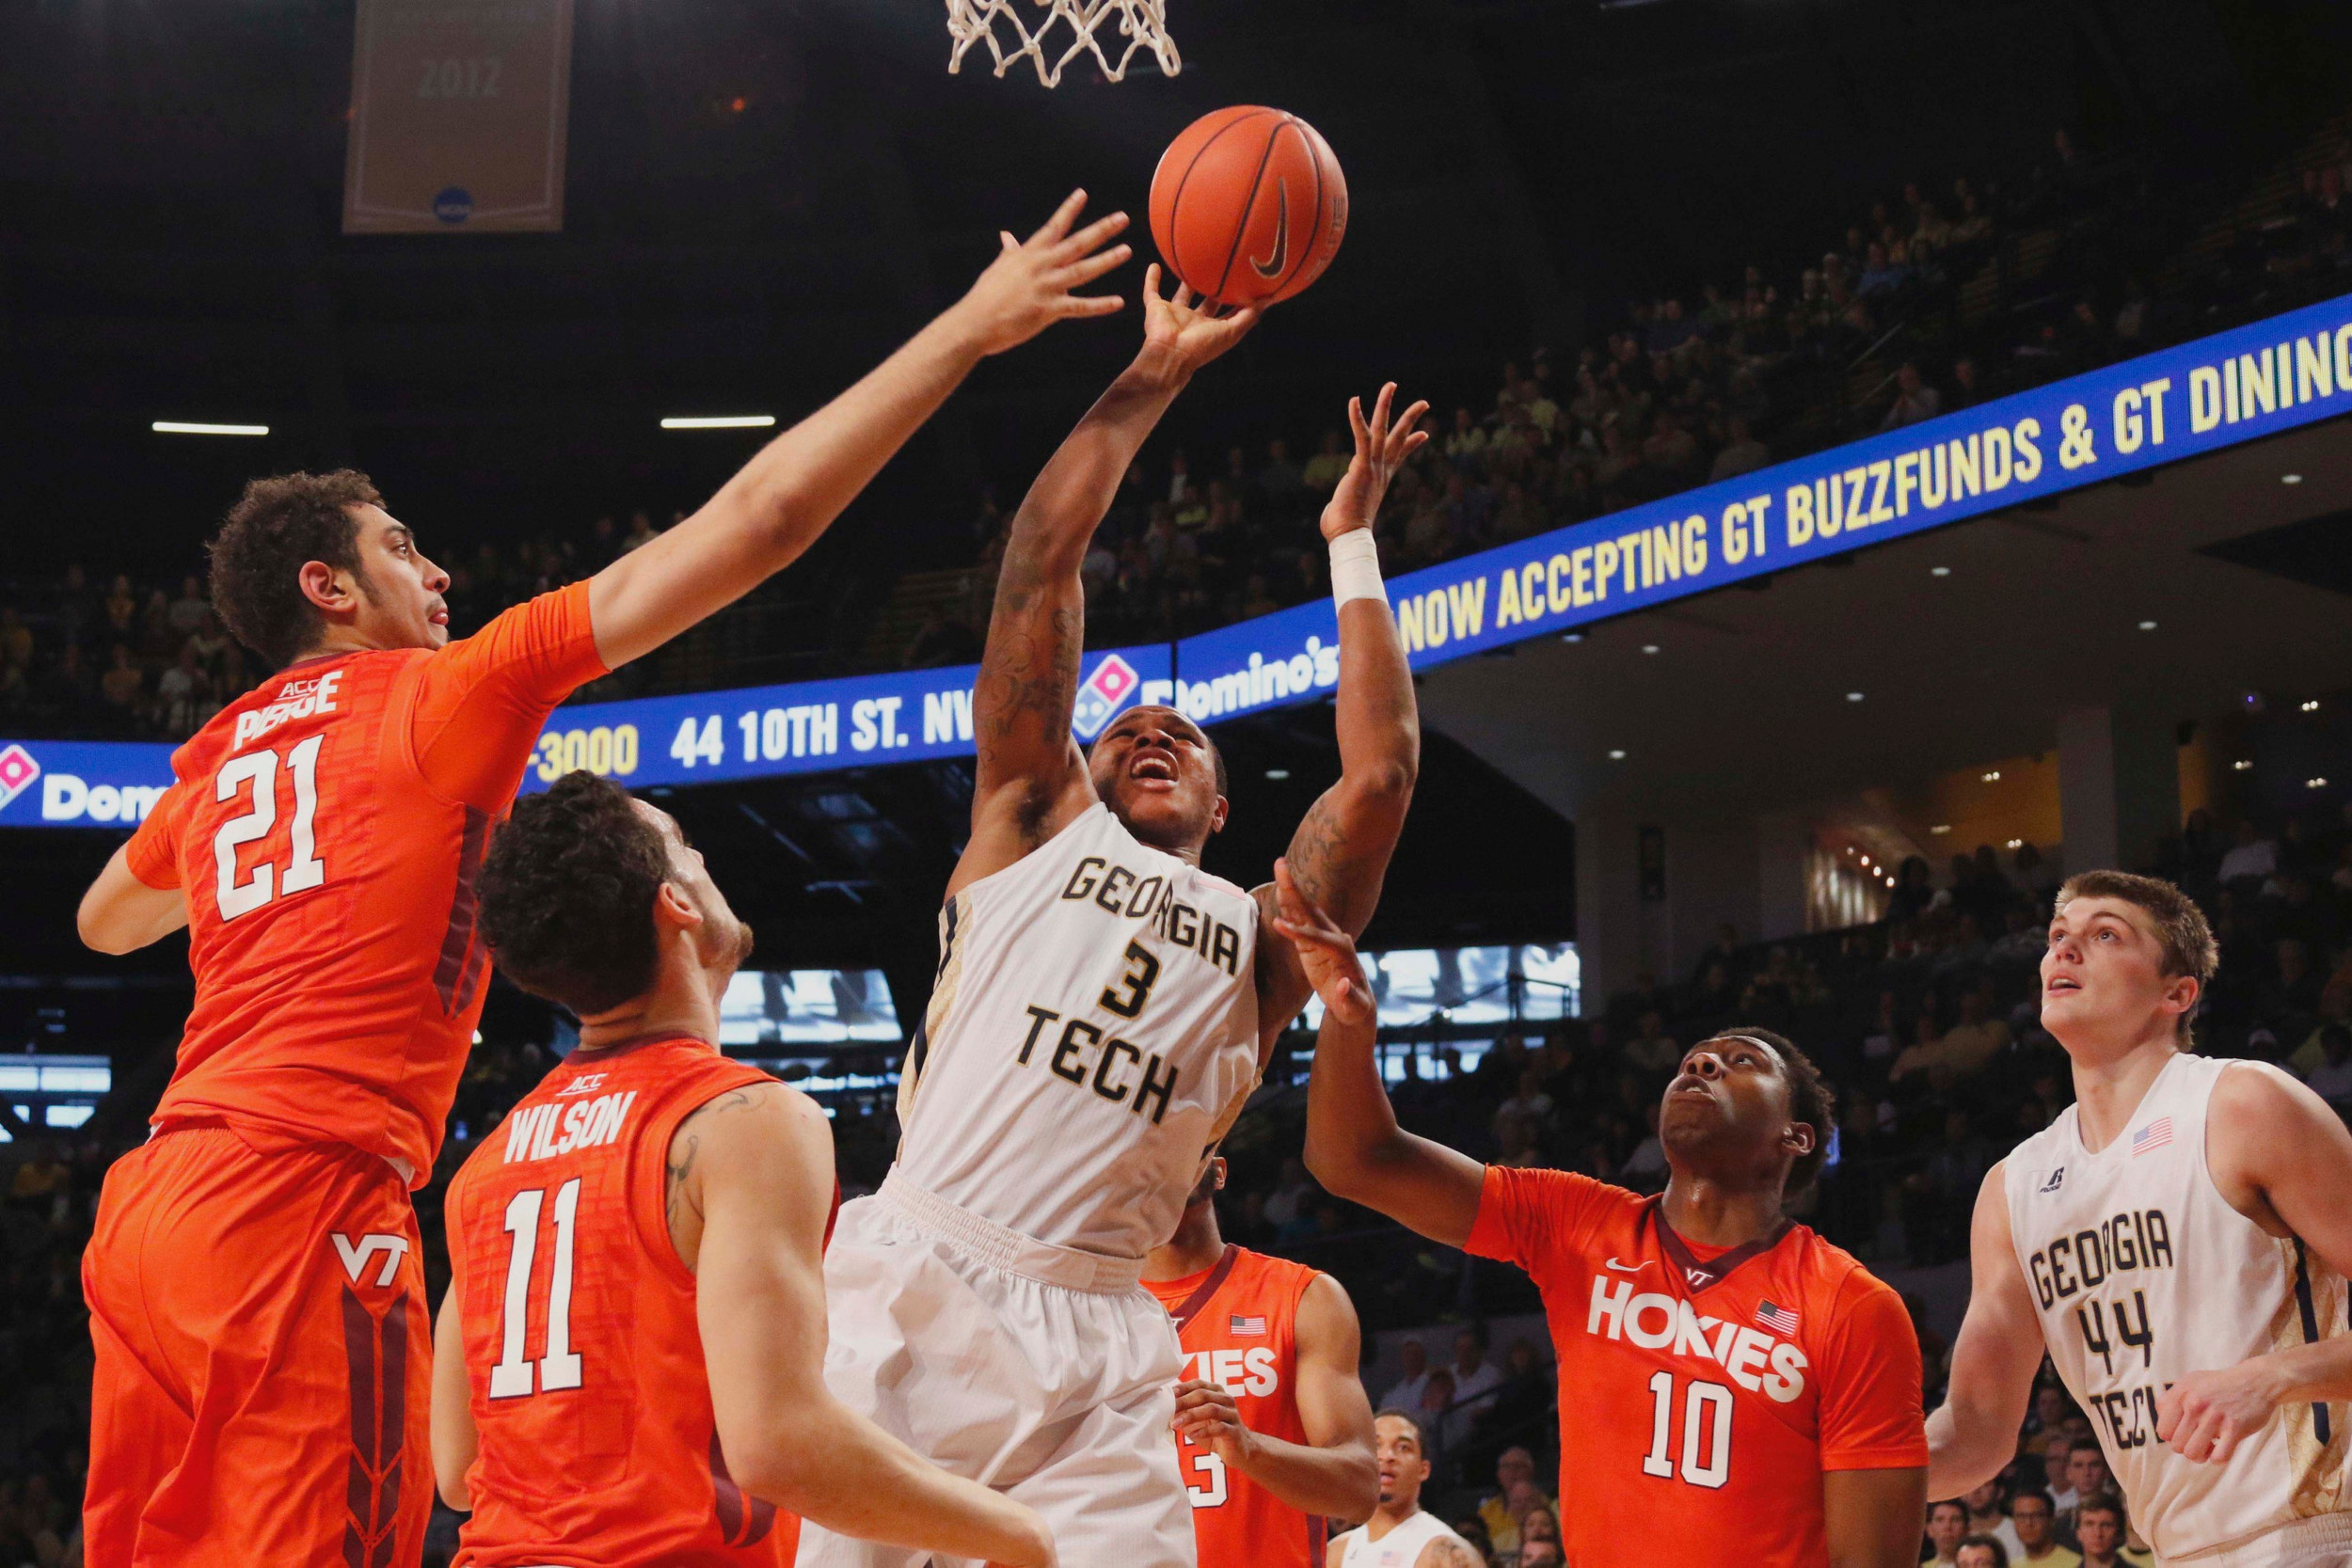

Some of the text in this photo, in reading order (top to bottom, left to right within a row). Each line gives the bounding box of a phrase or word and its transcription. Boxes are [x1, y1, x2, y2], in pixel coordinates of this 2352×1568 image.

[417, 56, 503, 99] 2012
[1398, 577, 1487, 656] NOW
[1495, 515, 1708, 629] ACCEPTING
[1722, 494, 1772, 564] GT
[1787, 418, 2043, 547] BUZZFUNDS
[2058, 404, 2098, 470] &
[2113, 377, 2171, 455] GT
[670, 714, 724, 768] 44
[739, 703, 838, 763] 10TH
[850, 696, 910, 752] ST.
[214, 733, 326, 924] 21
[1061, 857, 1241, 977] GEORGIA
[1097, 937, 1164, 1021] 3
[562, 1072, 610, 1093] ACC
[1015, 1004, 1179, 1126] TECH
[503, 1091, 638, 1164] WILSON
[328, 1230, 409, 1290] VT
[488, 1176, 584, 1401] 11
[1685, 1267, 1714, 1287] VT
[2029, 1208, 2174, 1312] GEORGIA
[1587, 1274, 1808, 1403] HOKIES
[2076, 1287, 2153, 1377] 44
[1642, 1370, 1735, 1490] 10
